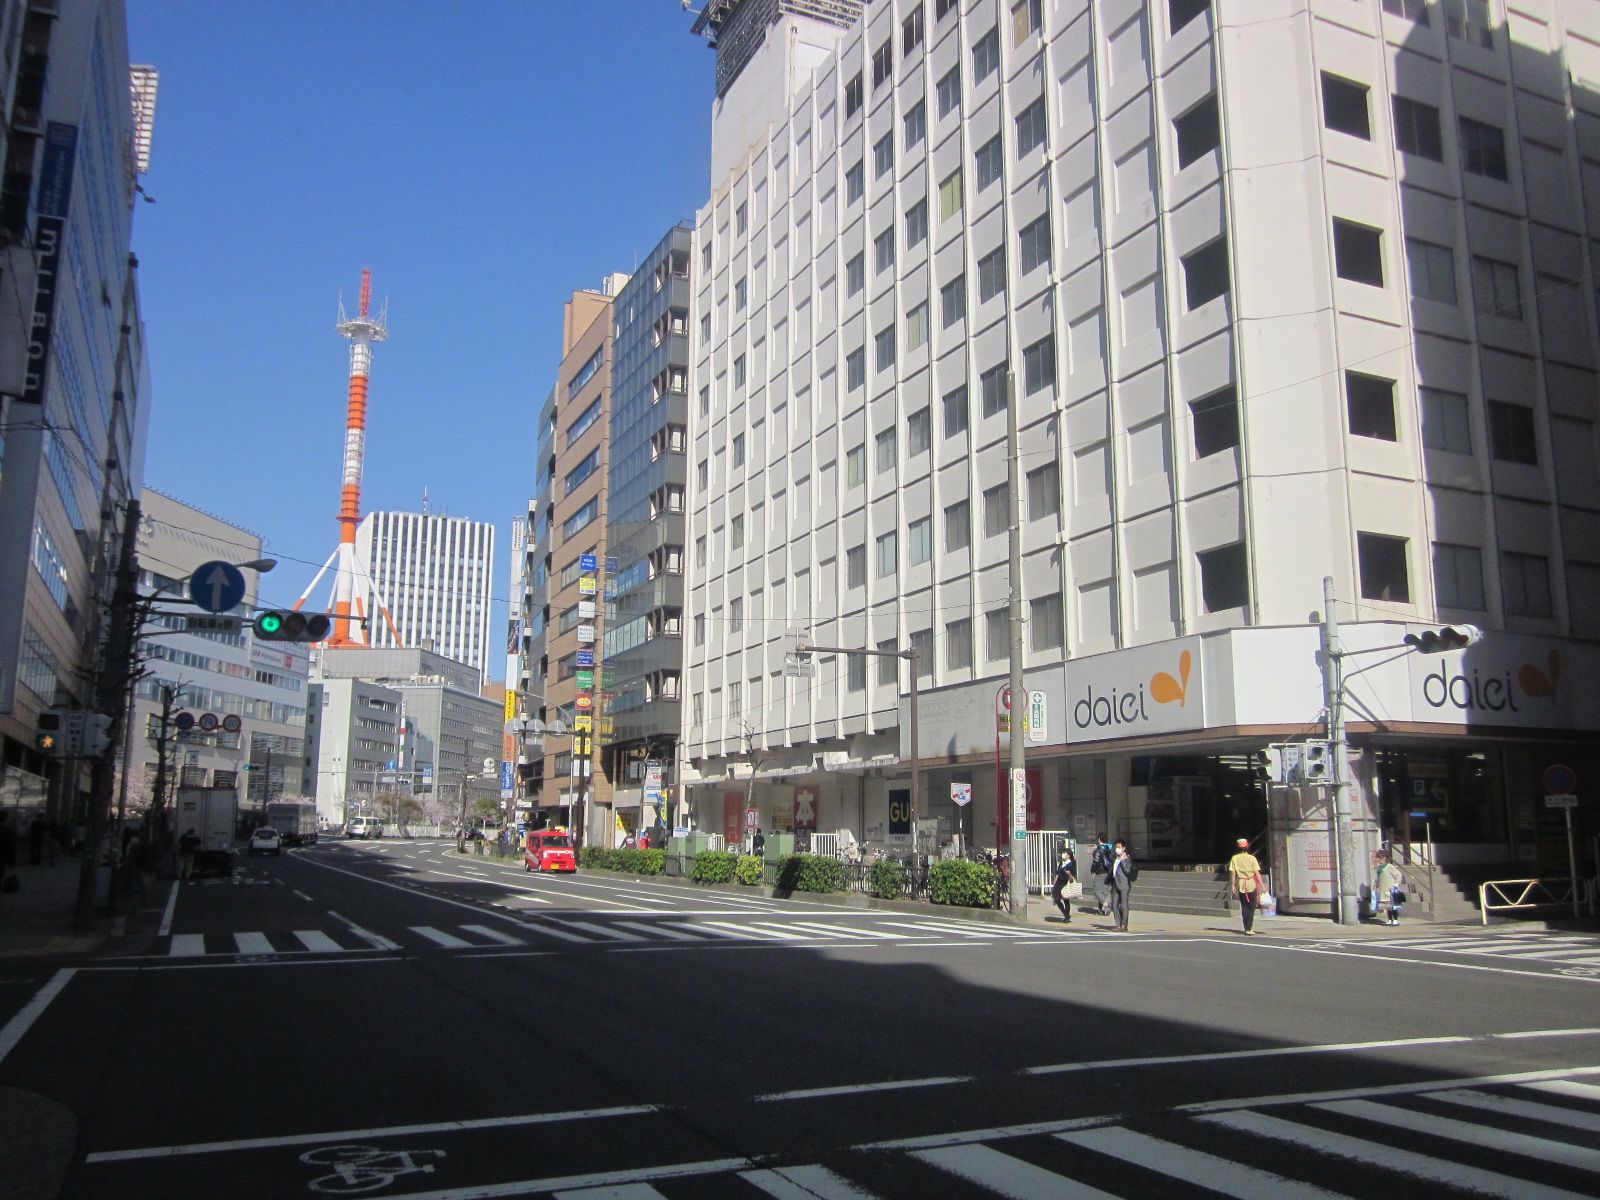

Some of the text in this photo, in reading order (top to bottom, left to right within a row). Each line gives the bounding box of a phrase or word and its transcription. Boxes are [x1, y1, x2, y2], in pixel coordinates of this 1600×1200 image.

[1074, 682, 1149, 729] daiei
[1422, 658, 1519, 713] daiei
[795, 788, 816, 827] 本
[889, 801, 910, 823] GU
